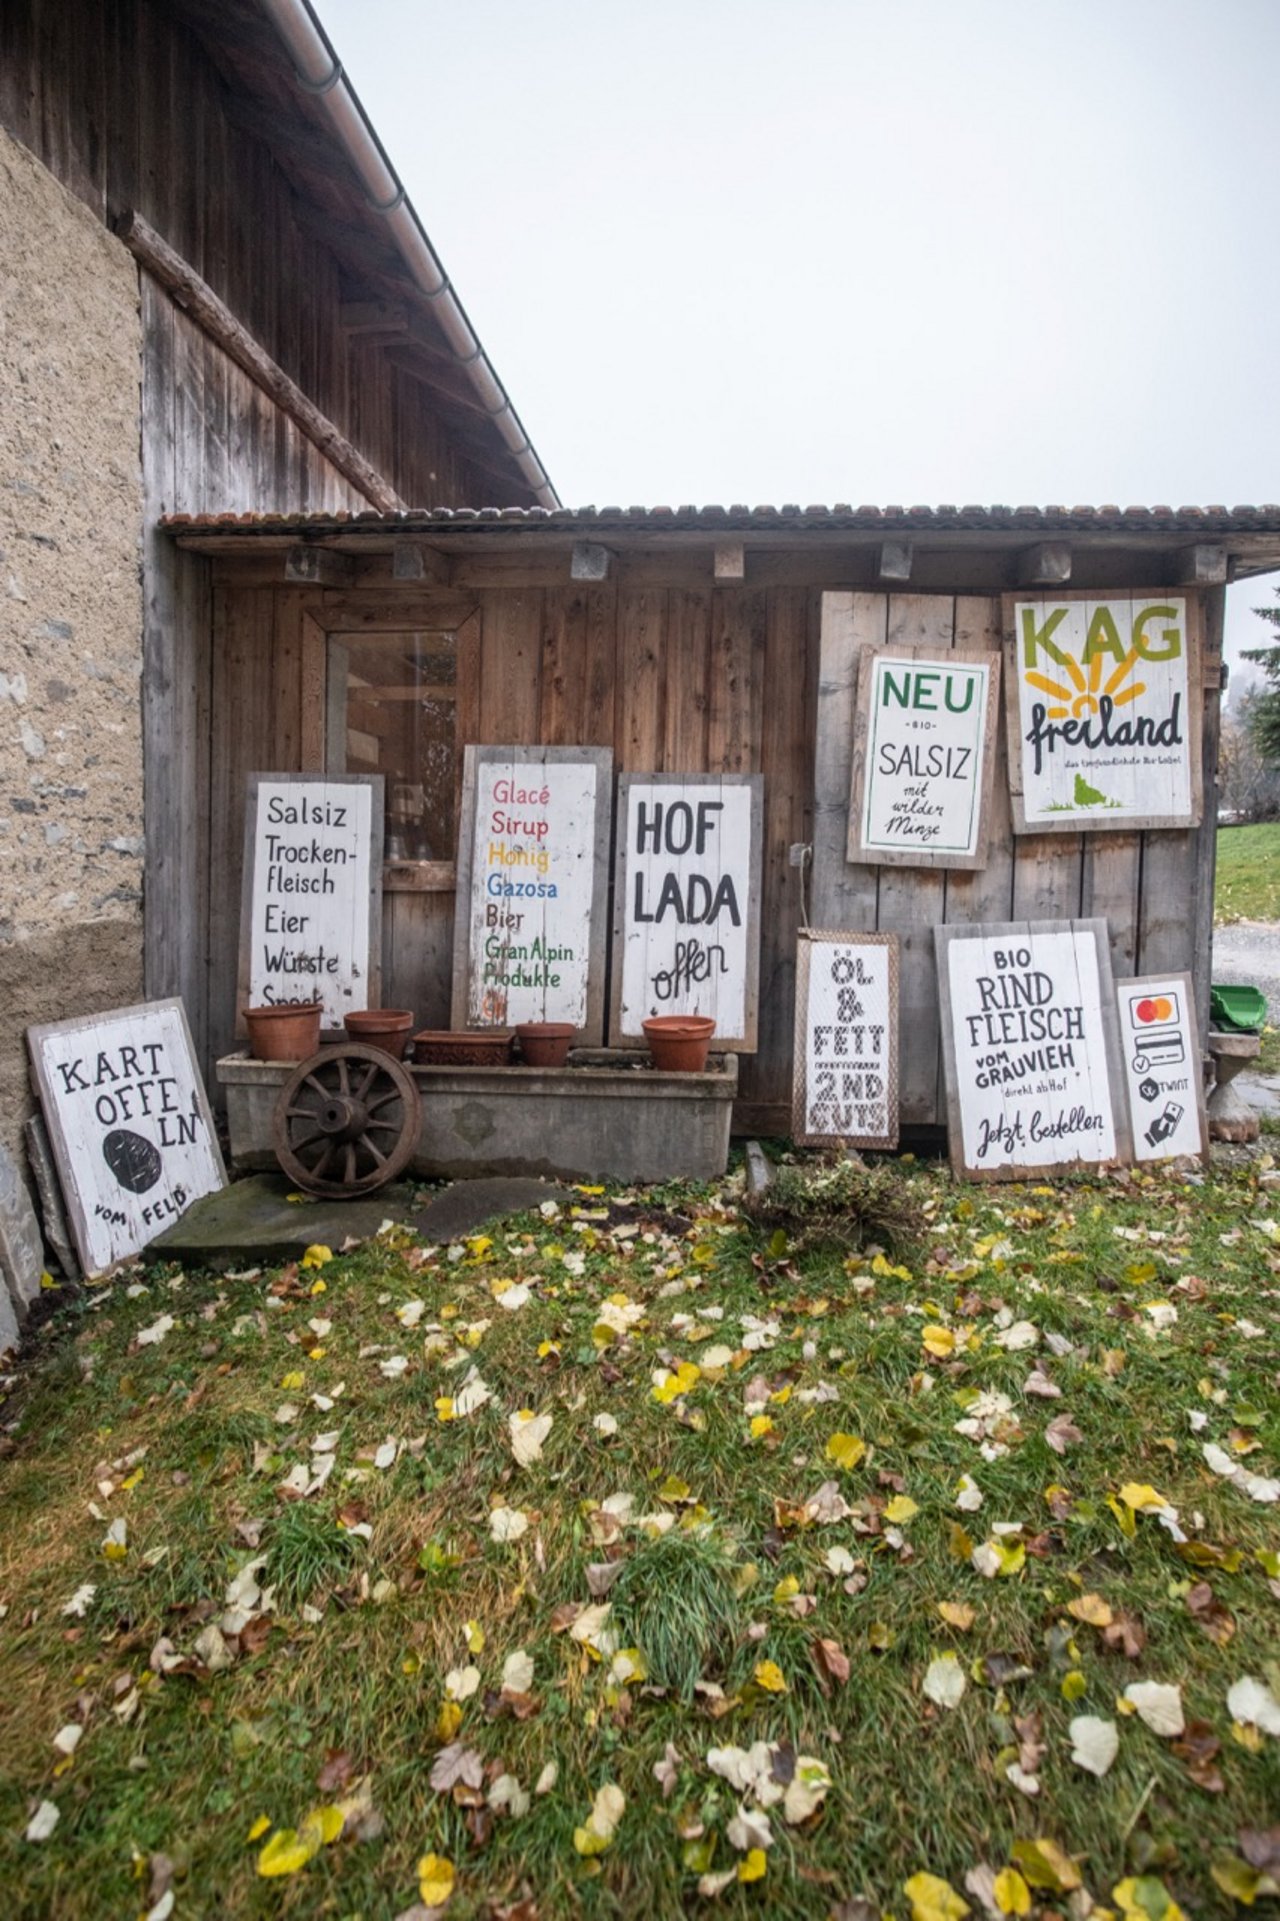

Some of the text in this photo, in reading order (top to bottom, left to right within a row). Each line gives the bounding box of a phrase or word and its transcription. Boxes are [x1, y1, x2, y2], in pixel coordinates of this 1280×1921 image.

[1021, 606, 1181, 669] KAG
[882, 671, 974, 713] NEU
[1026, 692, 1182, 775] freiland
[879, 743, 971, 779] SALSIZ
[493, 781, 550, 806] Glacé
[903, 781, 929, 797] mit
[267, 797, 347, 828] Salsiz
[892, 798, 944, 816] wilder
[491, 812, 549, 841] Sirup
[637, 801, 724, 855] HOF
[885, 816, 941, 841] Minze
[266, 835, 357, 864] Trocken-
[488, 844, 550, 872] Honig
[487, 874, 558, 898] Gazosa
[634, 872, 741, 926] LADA
[265, 905, 309, 933] Eier
[486, 905, 524, 929] Bier
[264, 945, 339, 974] Würste
[652, 938, 728, 1000] offen
[831, 949, 874, 985] ÖL
[994, 949, 1031, 969] BIO
[483, 964, 561, 988] Produkte
[837, 986, 865, 1024] &
[976, 972, 1053, 1012] RIND
[814, 1025, 884, 1055] FETT
[966, 1008, 1085, 1047] FLEISCH
[58, 1044, 163, 1094] KART
[976, 1051, 1009, 1068] VOM
[976, 1043, 1075, 1089] GRAUVIEH
[95, 1078, 178, 1125] OFFE
[815, 1072, 884, 1101] 2ND
[1004, 1086, 1033, 1098] direkt
[158, 1113, 199, 1147] LN
[977, 1106, 1104, 1158] Jetzt bestellen
[94, 1189, 187, 1225] VOM FELD
